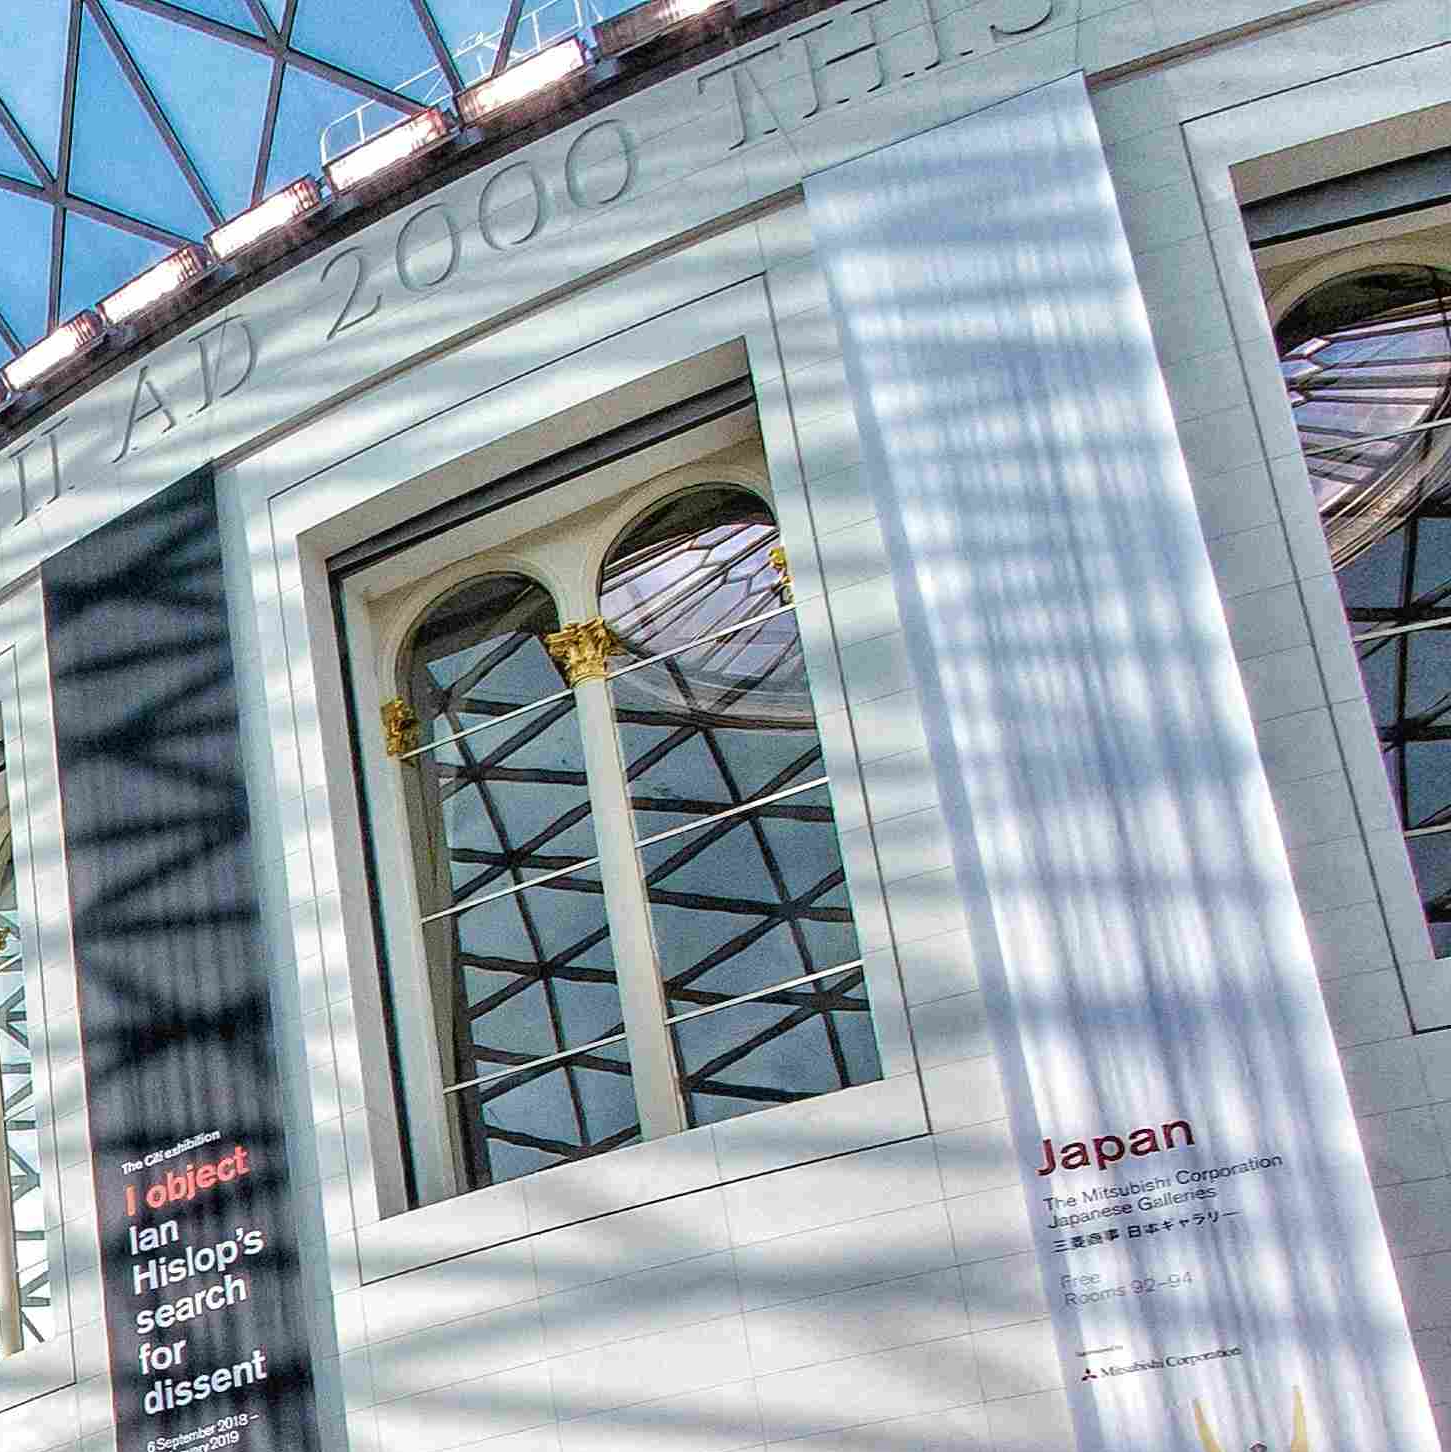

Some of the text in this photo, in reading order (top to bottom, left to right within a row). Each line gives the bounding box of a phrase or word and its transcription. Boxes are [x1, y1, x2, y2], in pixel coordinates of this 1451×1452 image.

[112, 314, 257, 464] AD
[320, 118, 637, 341] 2000
[121, 1159, 143, 1175] The
[164, 1130, 221, 1160] exhibition
[1036, 1119, 1195, 1176] Japan
[125, 1145, 250, 1216] I object
[1043, 1154, 1283, 1212] The Mitsubishi Corporation
[1047, 1187, 1216, 1229] Japanese Galleries
[129, 1219, 179, 1256] Ian
[136, 1274, 247, 1334] search
[1065, 1282, 1127, 1307] Rooms
[139, 1339, 186, 1375] for
[144, 1349, 267, 1415] dissent
[157, 1425, 216, 1451] September
[217, 1414, 248, 1432] 2018
[210, 1431, 240, 1450] 2019
